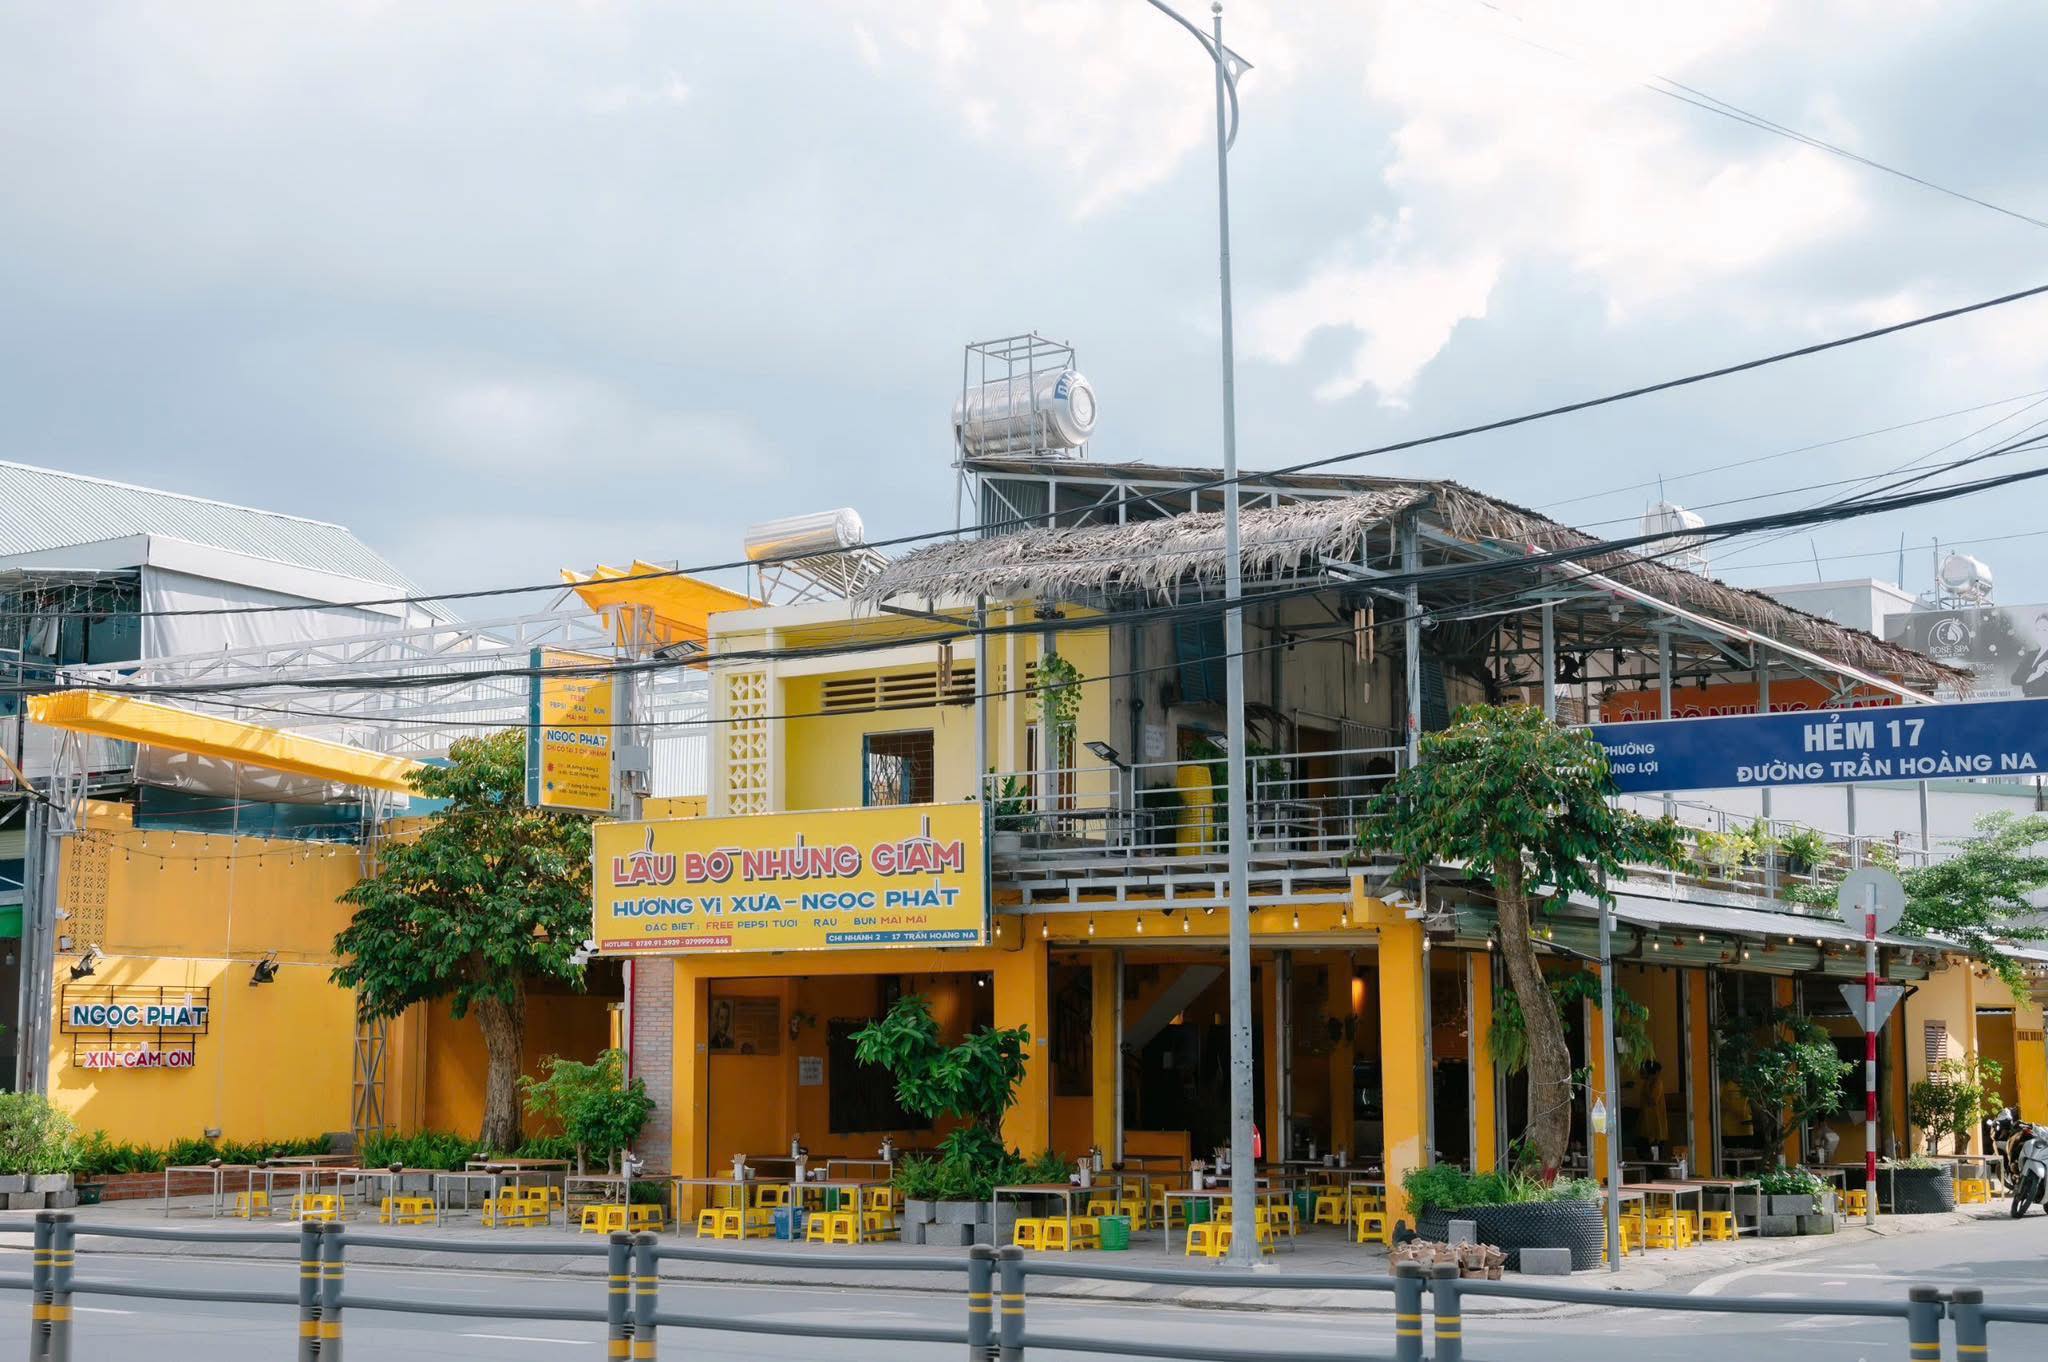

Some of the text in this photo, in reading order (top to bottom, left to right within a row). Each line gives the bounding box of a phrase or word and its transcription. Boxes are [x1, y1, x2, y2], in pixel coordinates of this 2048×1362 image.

[1929, 644, 1970, 655] ROSE SPA
[1803, 714, 1925, 752] HẺM 17
[1609, 760, 1658, 776] ƯNG LỢI
[1736, 750, 2037, 783] ĐƯỜNG TRẦN HOÀNG NA
[612, 896, 695, 918] HƯƠNG
[731, 893, 783, 913] XƯA
[801, 891, 876, 911] NGỌC
[706, 921, 734, 930] FREE
[737, 920, 769, 929] PEPSI
[813, 918, 837, 927] RAU
[963, 932, 976, 940] NA
[72, 993, 208, 1028] NGỌC PHÁT
[87, 1051, 116, 1067] XIN
[168, 1049, 193, 1067] ƠN
